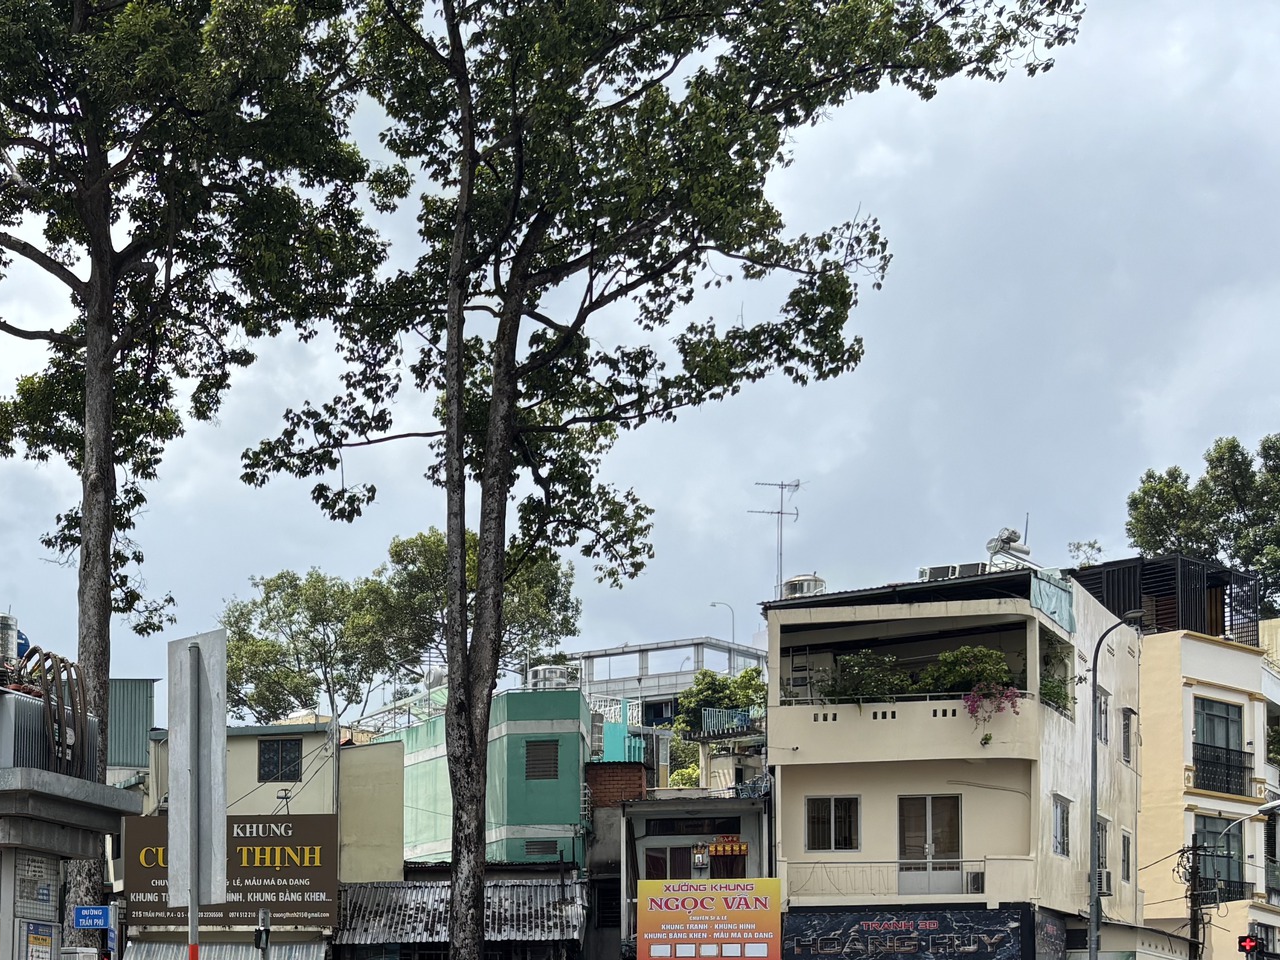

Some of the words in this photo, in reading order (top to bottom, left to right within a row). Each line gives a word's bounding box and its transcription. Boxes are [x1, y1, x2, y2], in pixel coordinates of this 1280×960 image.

[233, 823, 293, 838] KHUNG
[237, 845, 322, 870] THỊNH
[233, 878, 242, 887] LẺ,
[244, 877, 262, 886] MẪU
[263, 877, 276, 886] MÃ
[289, 879, 310, 887] DẠNG
[664, 882, 707, 893] XƯỞNG
[710, 883, 754, 892] KHUNG
[130, 892, 158, 901] KHUNG
[247, 892, 276, 901] KHUNG
[279, 889, 303, 901] BẰNG
[648, 896, 715, 914] NGỌC
[81, 908, 103, 916] ĐƯỜNG
[79, 916, 93, 926] TRẦN
[93, 917, 104, 926] PHÚ
[860, 920, 914, 931] TRANH
[918, 920, 939, 930] 3D
[929, 934, 1005, 953] HUY
